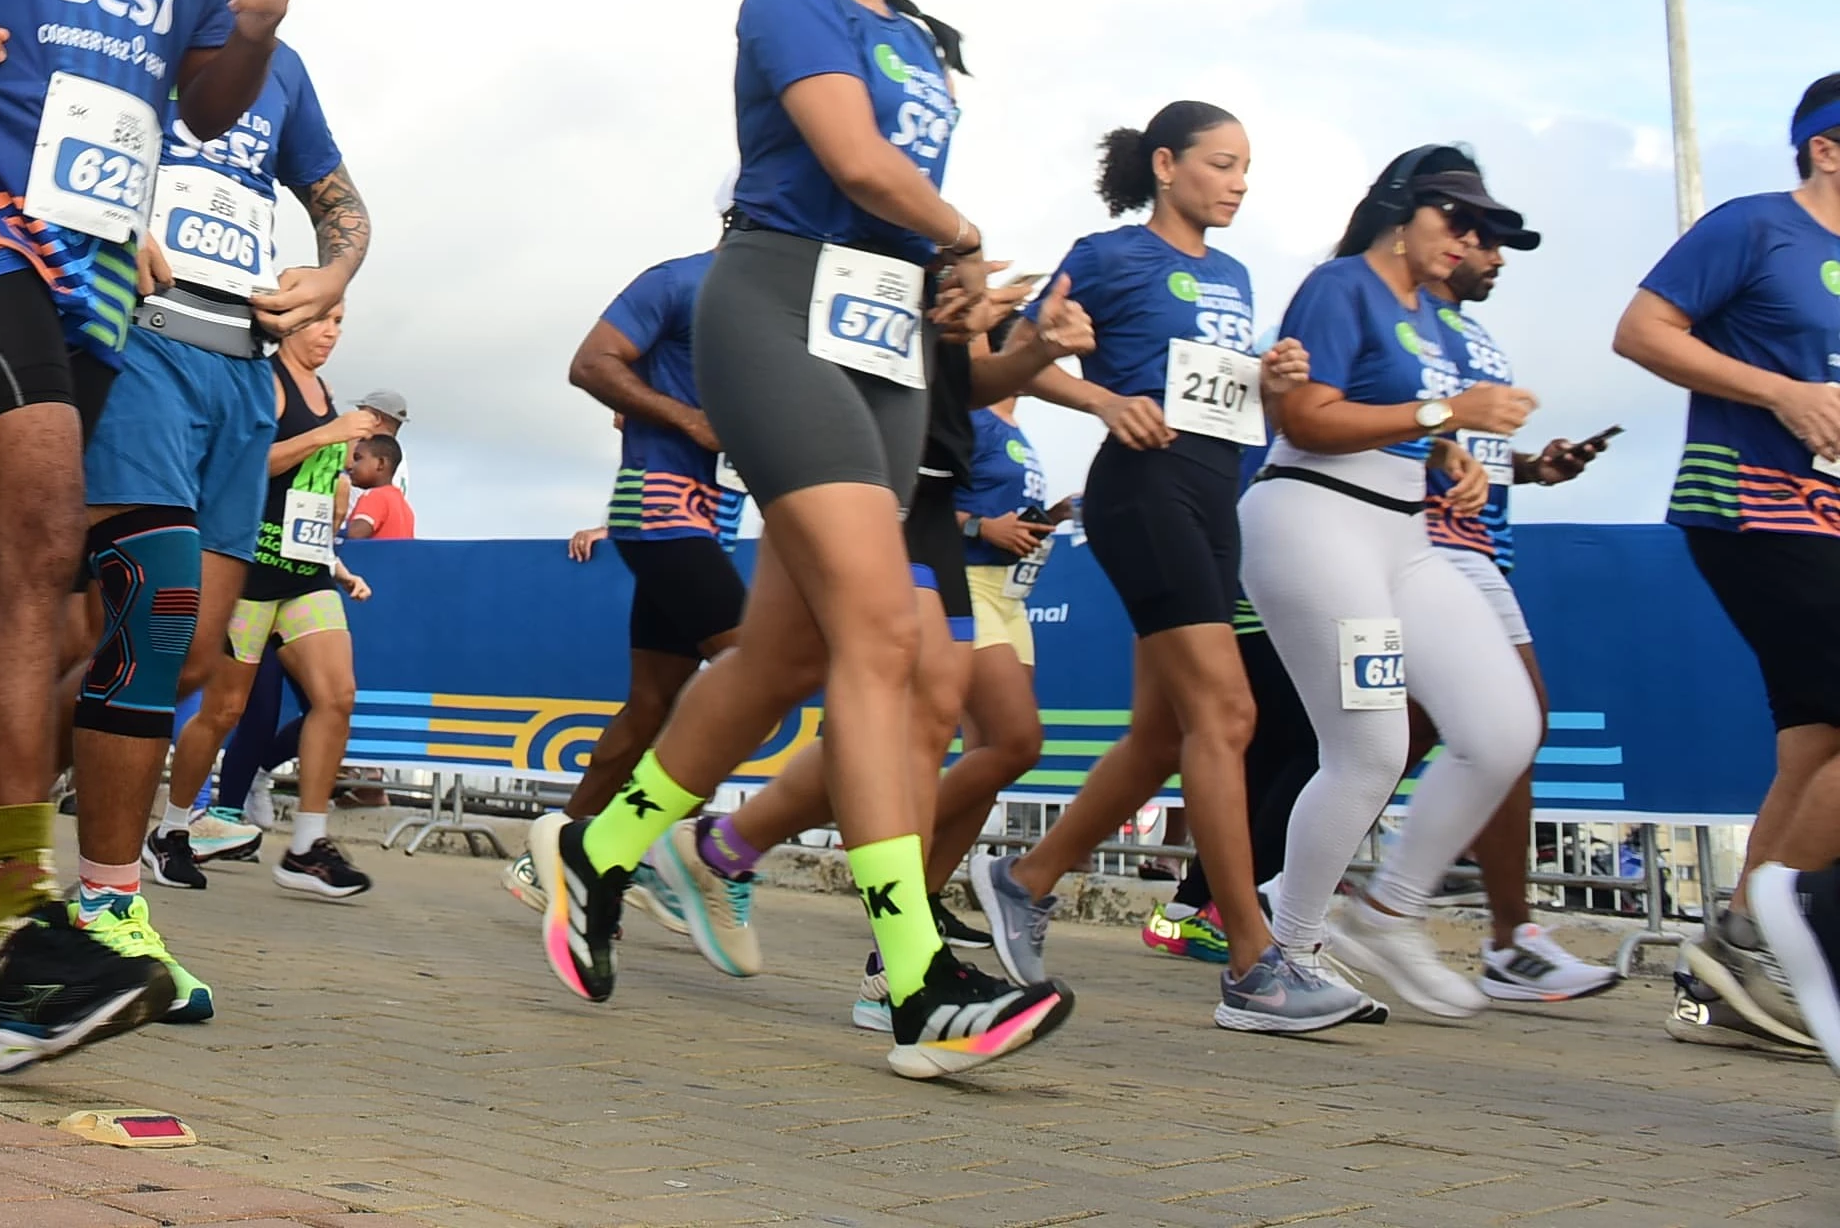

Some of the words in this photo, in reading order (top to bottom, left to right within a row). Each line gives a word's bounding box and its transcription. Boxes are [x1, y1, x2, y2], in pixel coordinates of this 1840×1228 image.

[37, 23, 104, 52] CORRER
[177, 216, 255, 267] 6806
[1181, 372, 1248, 412] 2107
[1029, 603, 1069, 623] nal
